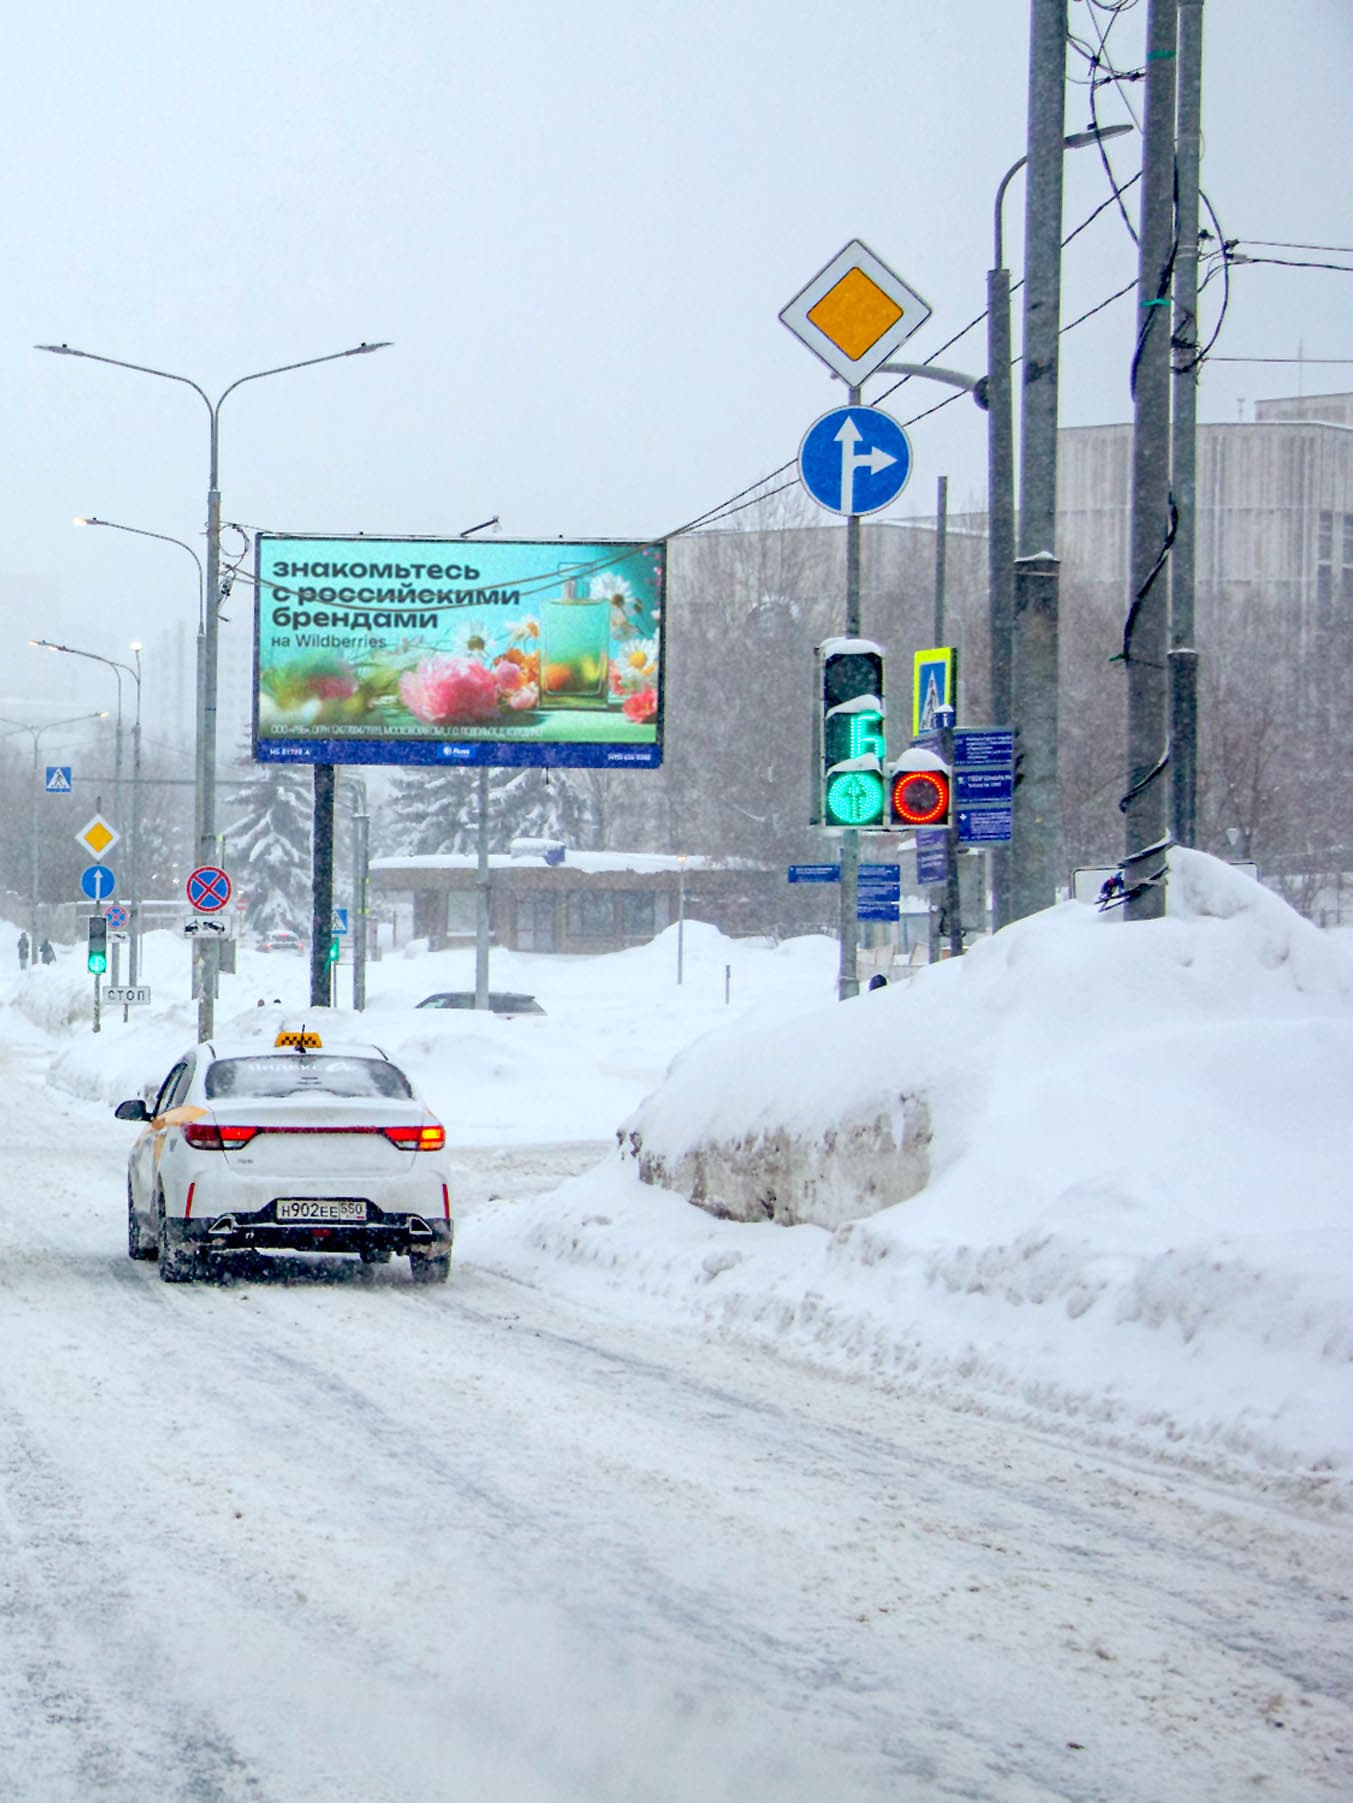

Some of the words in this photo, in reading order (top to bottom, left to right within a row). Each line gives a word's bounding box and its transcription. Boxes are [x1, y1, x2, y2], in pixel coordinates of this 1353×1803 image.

[272, 561, 481, 580] знакомьтесь
[272, 586, 291, 602] с
[298, 583, 520, 606] российскими
[272, 606, 438, 631] брендами
[271, 637, 290, 647] на
[295, 634, 387, 648] Wildberries
[108, 990, 145, 1000] СТОП
